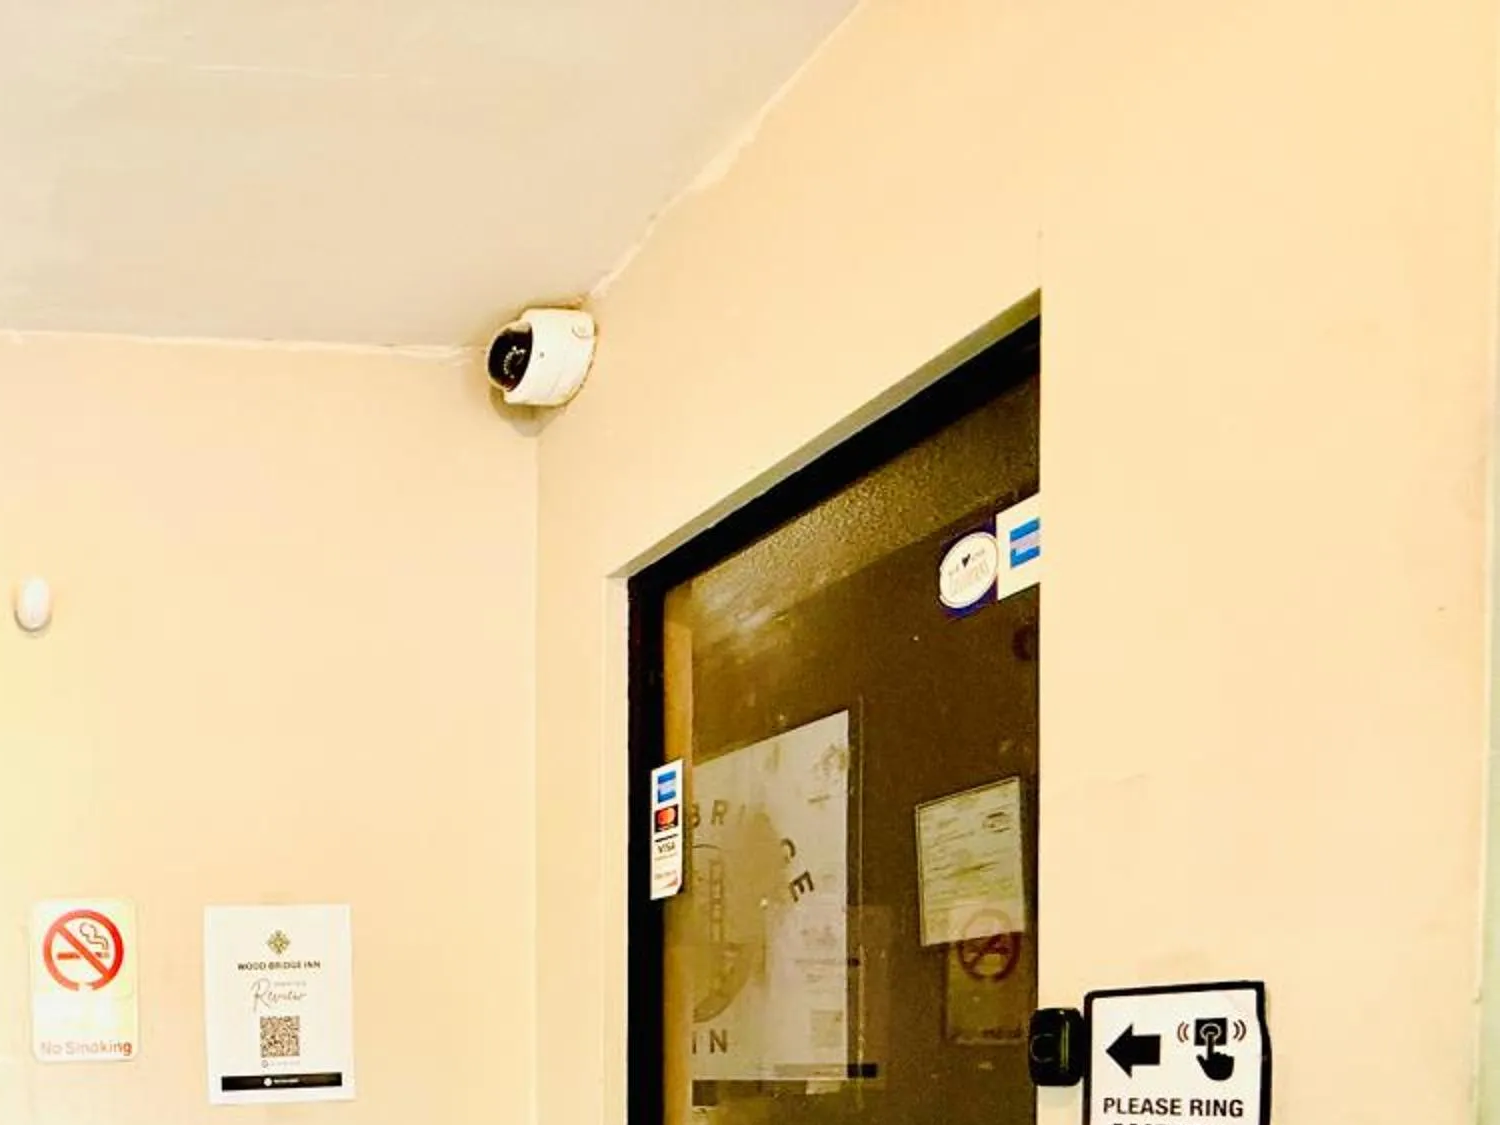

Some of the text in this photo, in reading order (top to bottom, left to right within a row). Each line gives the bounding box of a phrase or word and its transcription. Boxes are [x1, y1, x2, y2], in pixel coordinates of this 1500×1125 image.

[237, 961, 267, 971] WOOD
[304, 960, 321, 969] INN
[41, 1040, 134, 1057] No Smoking
[1102, 1096, 1244, 1118] PLEASE RING
